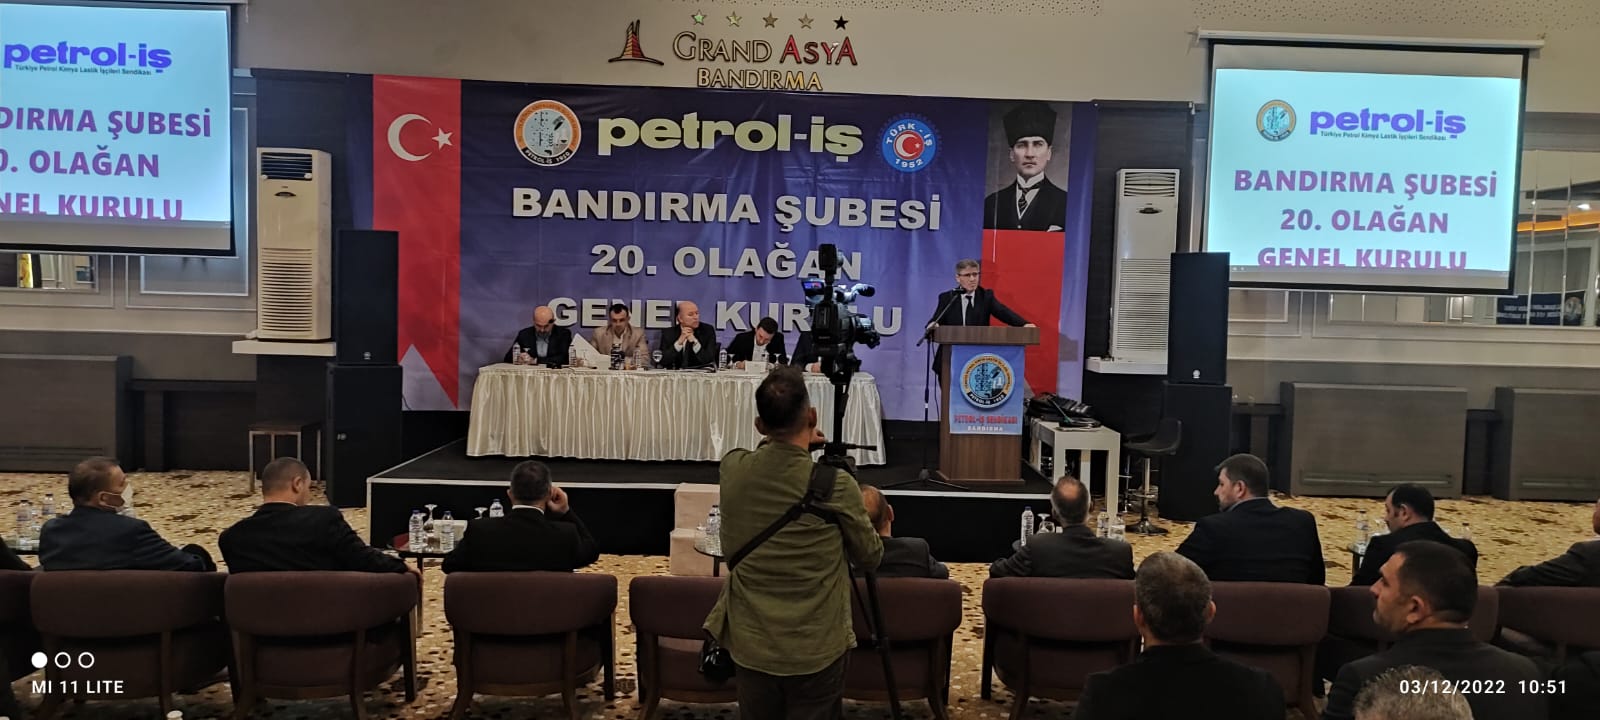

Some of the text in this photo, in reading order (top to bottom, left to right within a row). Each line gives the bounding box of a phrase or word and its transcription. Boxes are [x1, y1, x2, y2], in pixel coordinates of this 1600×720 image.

[4, 41, 172, 73] petrol-iş
[672, 31, 858, 66] GRAND ASYA
[15, 64, 38, 72] Türkiye
[697, 68, 823, 90] BANDIRMA
[108, 108, 211, 140] ŞUBESİ
[598, 112, 864, 162] petrol-iş
[1310, 108, 1467, 139] petrol-iş
[29, 145, 159, 177] OLAĞAN
[1234, 169, 1497, 200] BANDIRMA ŞUBESİ
[58, 195, 182, 221] KURULU
[512, 187, 941, 232] BANDIRMA ŞUBESİ
[1280, 205, 1449, 234] 20. OLAĞAN
[590, 244, 657, 275] 20.
[1257, 247, 1467, 270] GENEL KURULU
[548, 297, 902, 336] GENE KURU
